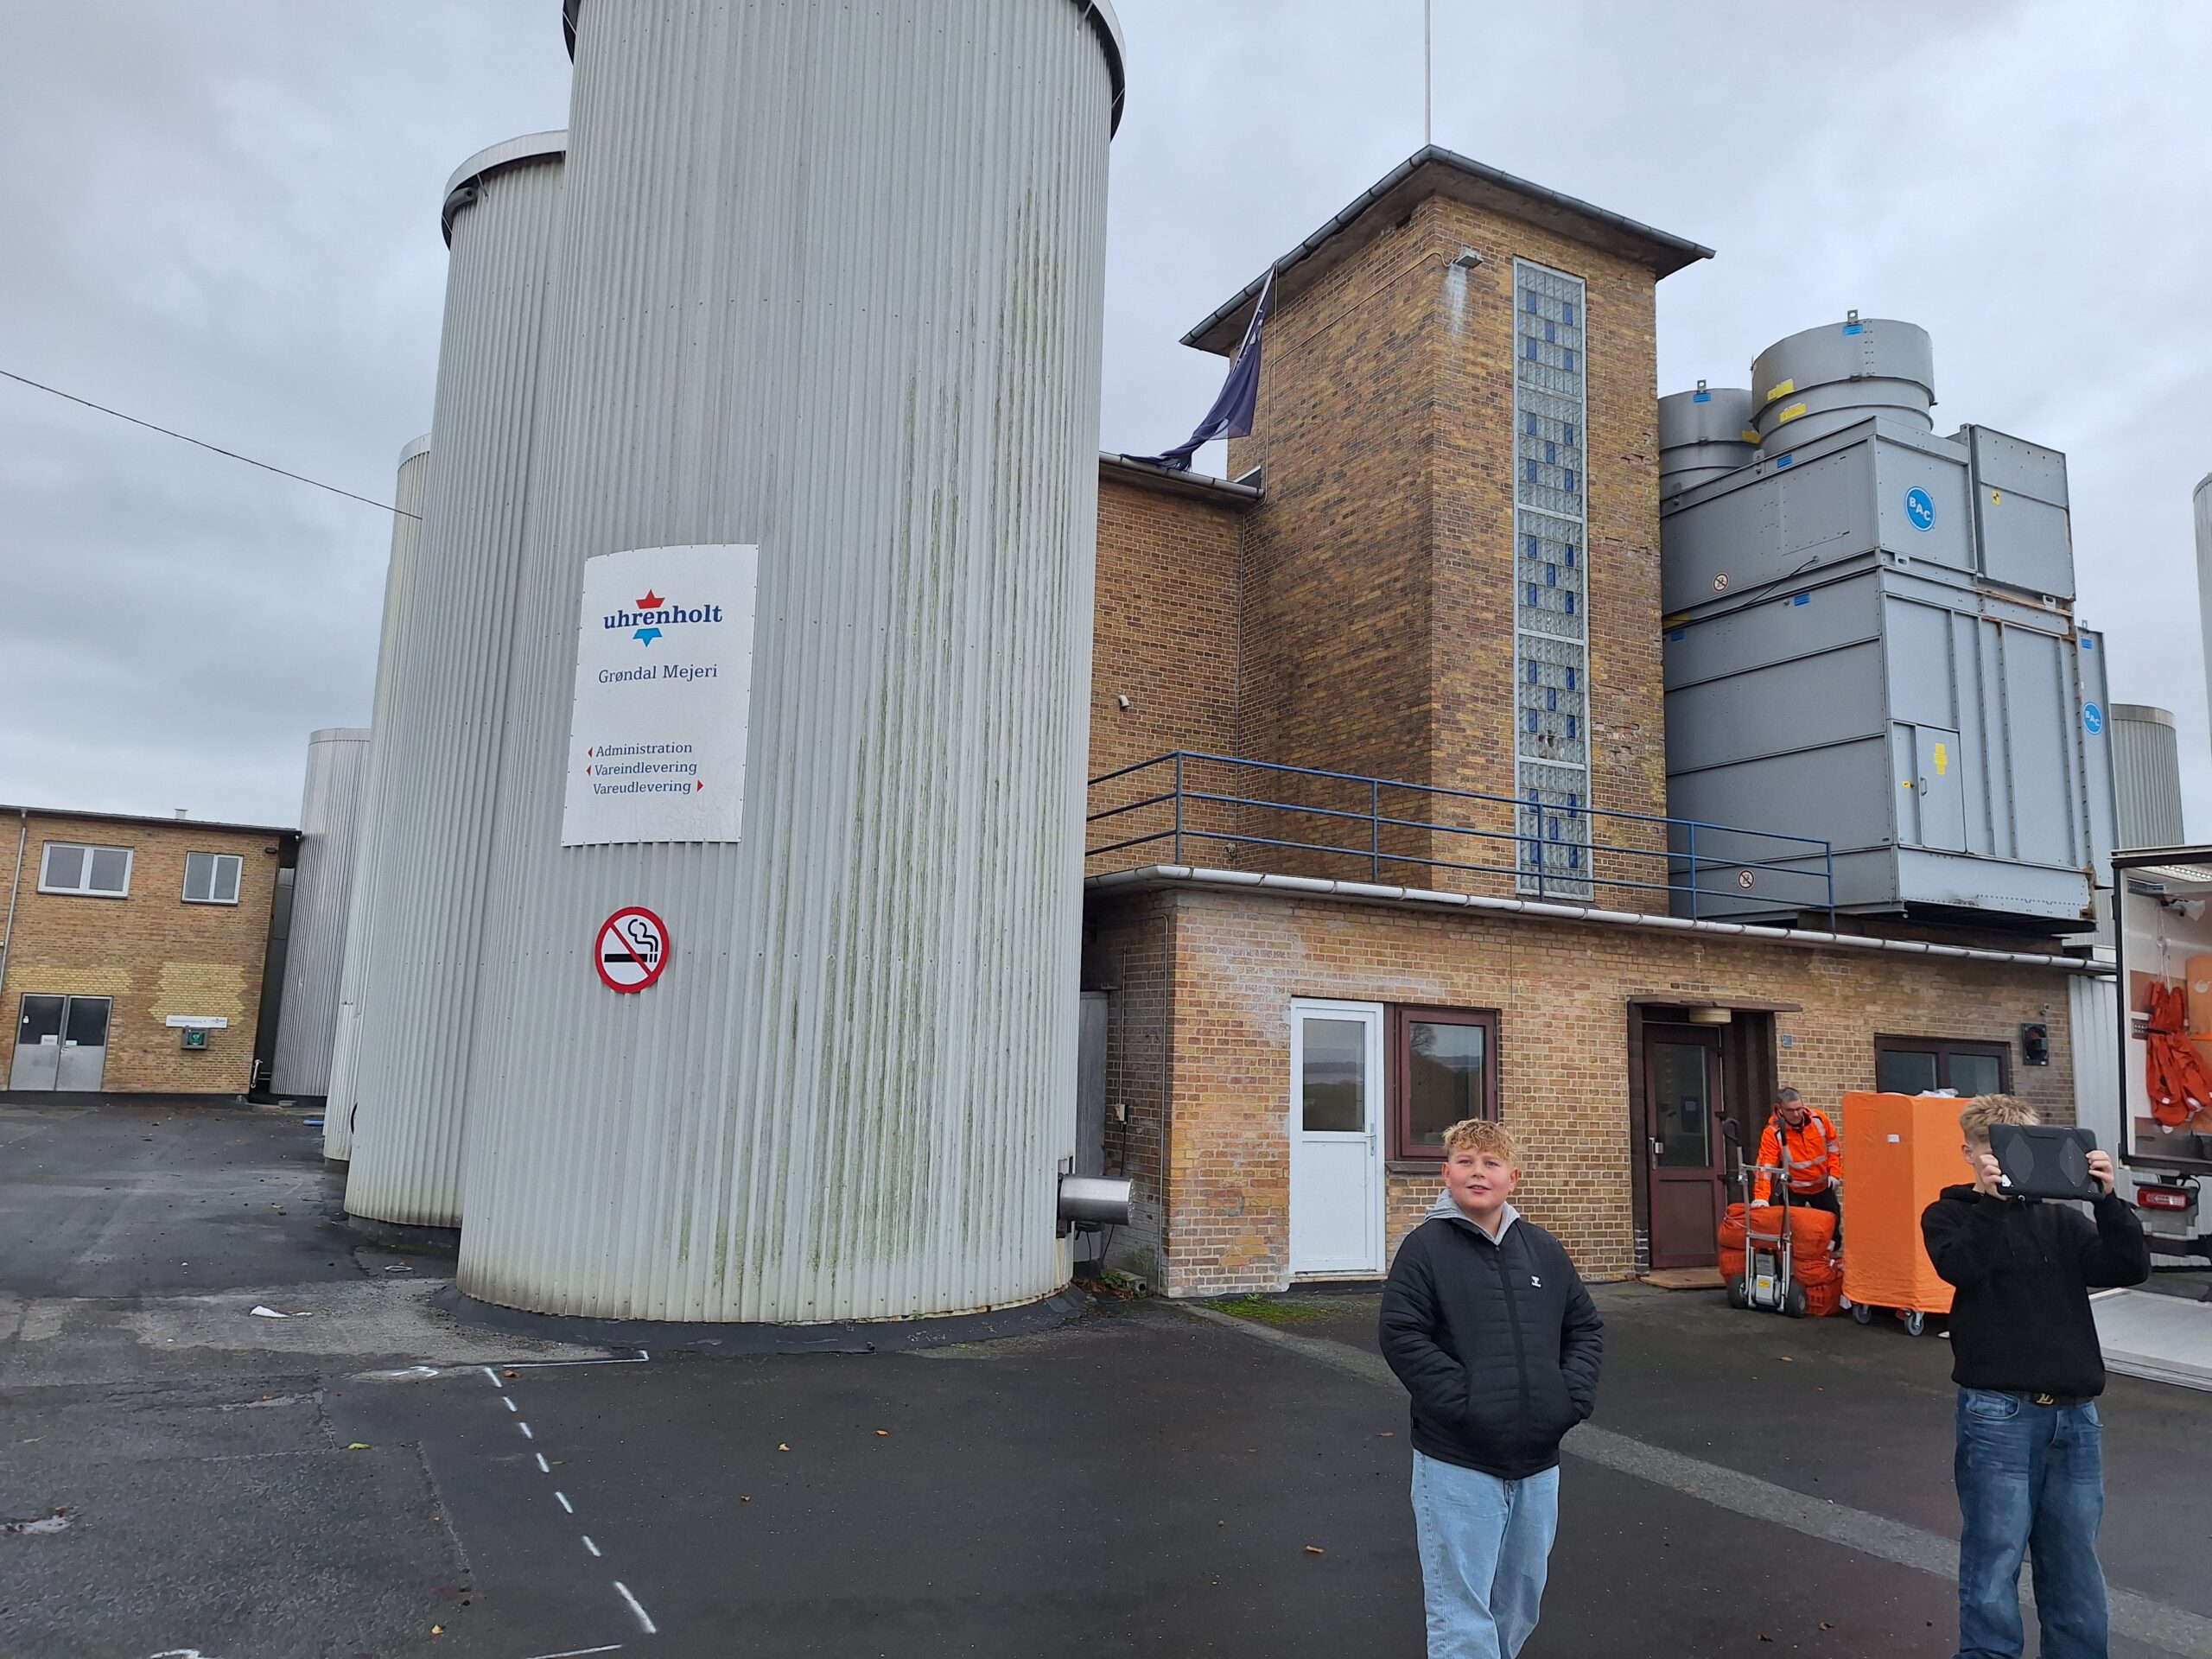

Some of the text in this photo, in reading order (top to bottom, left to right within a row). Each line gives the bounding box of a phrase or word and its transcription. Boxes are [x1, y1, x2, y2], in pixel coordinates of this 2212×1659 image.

[1909, 496, 1931, 521] BAC
[602, 604, 723, 630] uhrenholt
[598, 663, 718, 683] Grøndal Mejeri
[2085, 710, 2101, 727] BAC
[596, 743, 692, 758] Administration
[594, 760, 698, 776] Vareindlevering
[593, 779, 692, 795] Vareudlevering
